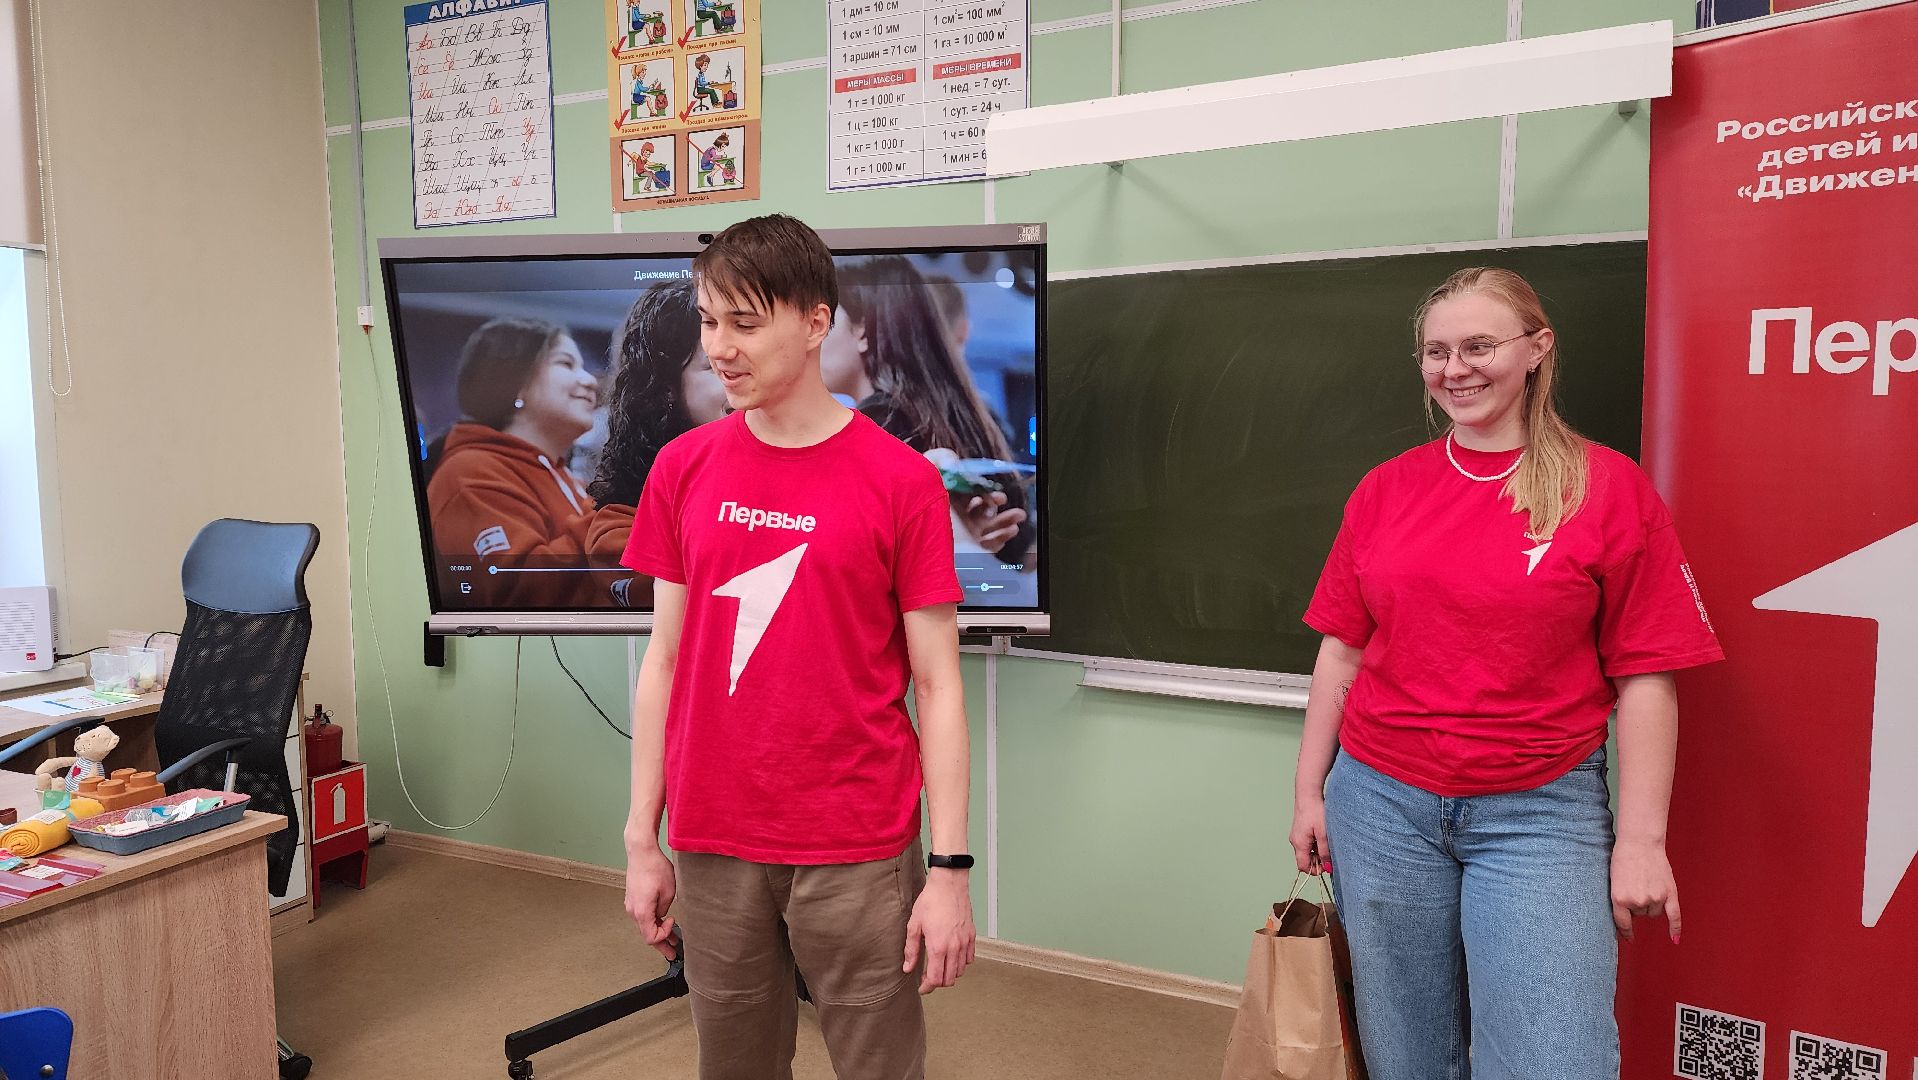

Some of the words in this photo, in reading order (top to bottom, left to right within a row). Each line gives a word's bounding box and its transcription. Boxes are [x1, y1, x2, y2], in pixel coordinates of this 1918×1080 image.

[842, 8, 846, 18] 1
[850, 7, 863, 18] дм
[874, 1, 883, 12] 10
[887, 1, 899, 11] см
[934, 15, 938, 25] 1
[967, 8, 982, 20] 100
[843, 30, 847, 40] 1
[850, 31, 862, 40] см
[873, 24, 882, 35] 10
[886, 24, 900, 34] мм
[934, 39, 938, 49] 1
[942, 40, 951, 48] га
[964, 34, 974, 45] 10
[977, 30, 994, 42] 000
[843, 53, 847, 63] 1
[850, 50, 879, 64] аршин
[891, 45, 901, 56] 71
[904, 45, 917, 54] см
[942, 65, 968, 75] МЕРЫ
[970, 58, 1012, 71] ВРЕМЕНИ
[847, 78, 871, 89] МЕРЫ
[873, 73, 904, 84] МАССЫ
[943, 83, 947, 93] 1
[983, 78, 989, 88] 7
[992, 78, 1011, 89] сут.
[848, 98, 852, 108] 1
[870, 95, 875, 105] 1
[878, 93, 893, 104] 000
[896, 94, 905, 102] кг
[943, 107, 947, 117] 1
[951, 107, 969, 118] сут.
[981, 101, 992, 113] 24
[848, 121, 851, 131] 1
[855, 123, 860, 131] ц
[872, 117, 887, 128] 100
[890, 118, 898, 126] кг
[1716, 100, 1918, 143] Российск
[943, 130, 947, 140] 1
[968, 127, 979, 137] 60
[847, 143, 851, 153] 1
[855, 144, 863, 152] кг
[874, 140, 878, 150] 1
[882, 139, 897, 149] 000
[900, 139, 905, 147] г
[1757, 131, 1882, 171] детей
[1892, 132, 1918, 152] и
[943, 153, 947, 164] 1
[951, 154, 970, 163] мин
[847, 165, 851, 176] 1
[869, 163, 873, 173] 1
[877, 162, 892, 172] 000
[896, 162, 906, 171] мг
[1737, 164, 1918, 202] «Движен
[634, 270, 680, 280] Движение
[1748, 306, 1918, 396] Пер
[717, 501, 817, 533] Первые
